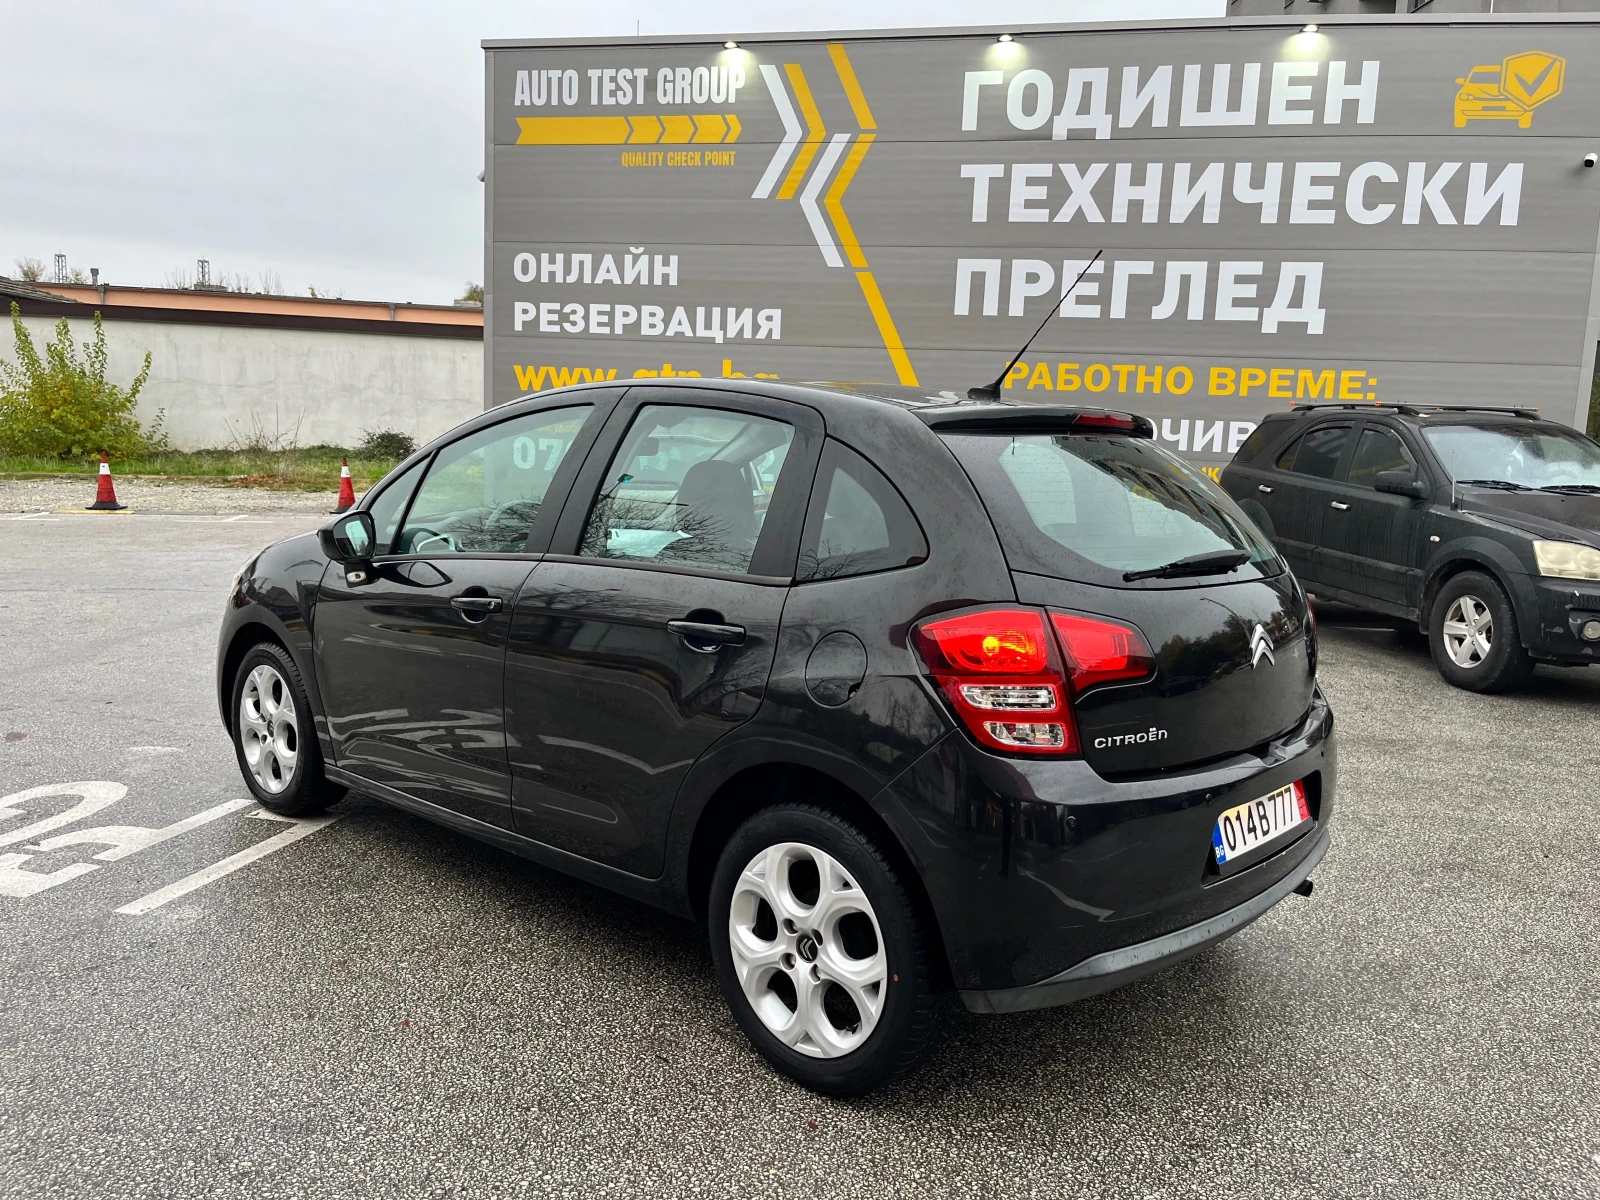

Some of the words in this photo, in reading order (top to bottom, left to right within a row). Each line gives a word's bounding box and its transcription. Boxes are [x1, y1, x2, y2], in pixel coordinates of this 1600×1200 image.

[514, 69, 579, 106] AUTO
[588, 68, 648, 105] TEST
[656, 67, 747, 104] GROUP
[962, 60, 1380, 140] ГОДИШЕН
[621, 152, 664, 167] QUALITY
[667, 152, 702, 167] CHECK
[704, 151, 736, 166] POINT
[960, 162, 1524, 226] ТЕХНИЧЕСКИ
[513, 246, 679, 286] ОНЛАЙН
[954, 258, 1326, 335] ПРЕГЛЕД
[514, 301, 782, 343] РЕЗЕРВАЦИЯ
[1003, 361, 1194, 396] РАБОТНО
[1207, 366, 1378, 401] ВРЕМЕ:
[1215, 845, 1225, 858] BG
